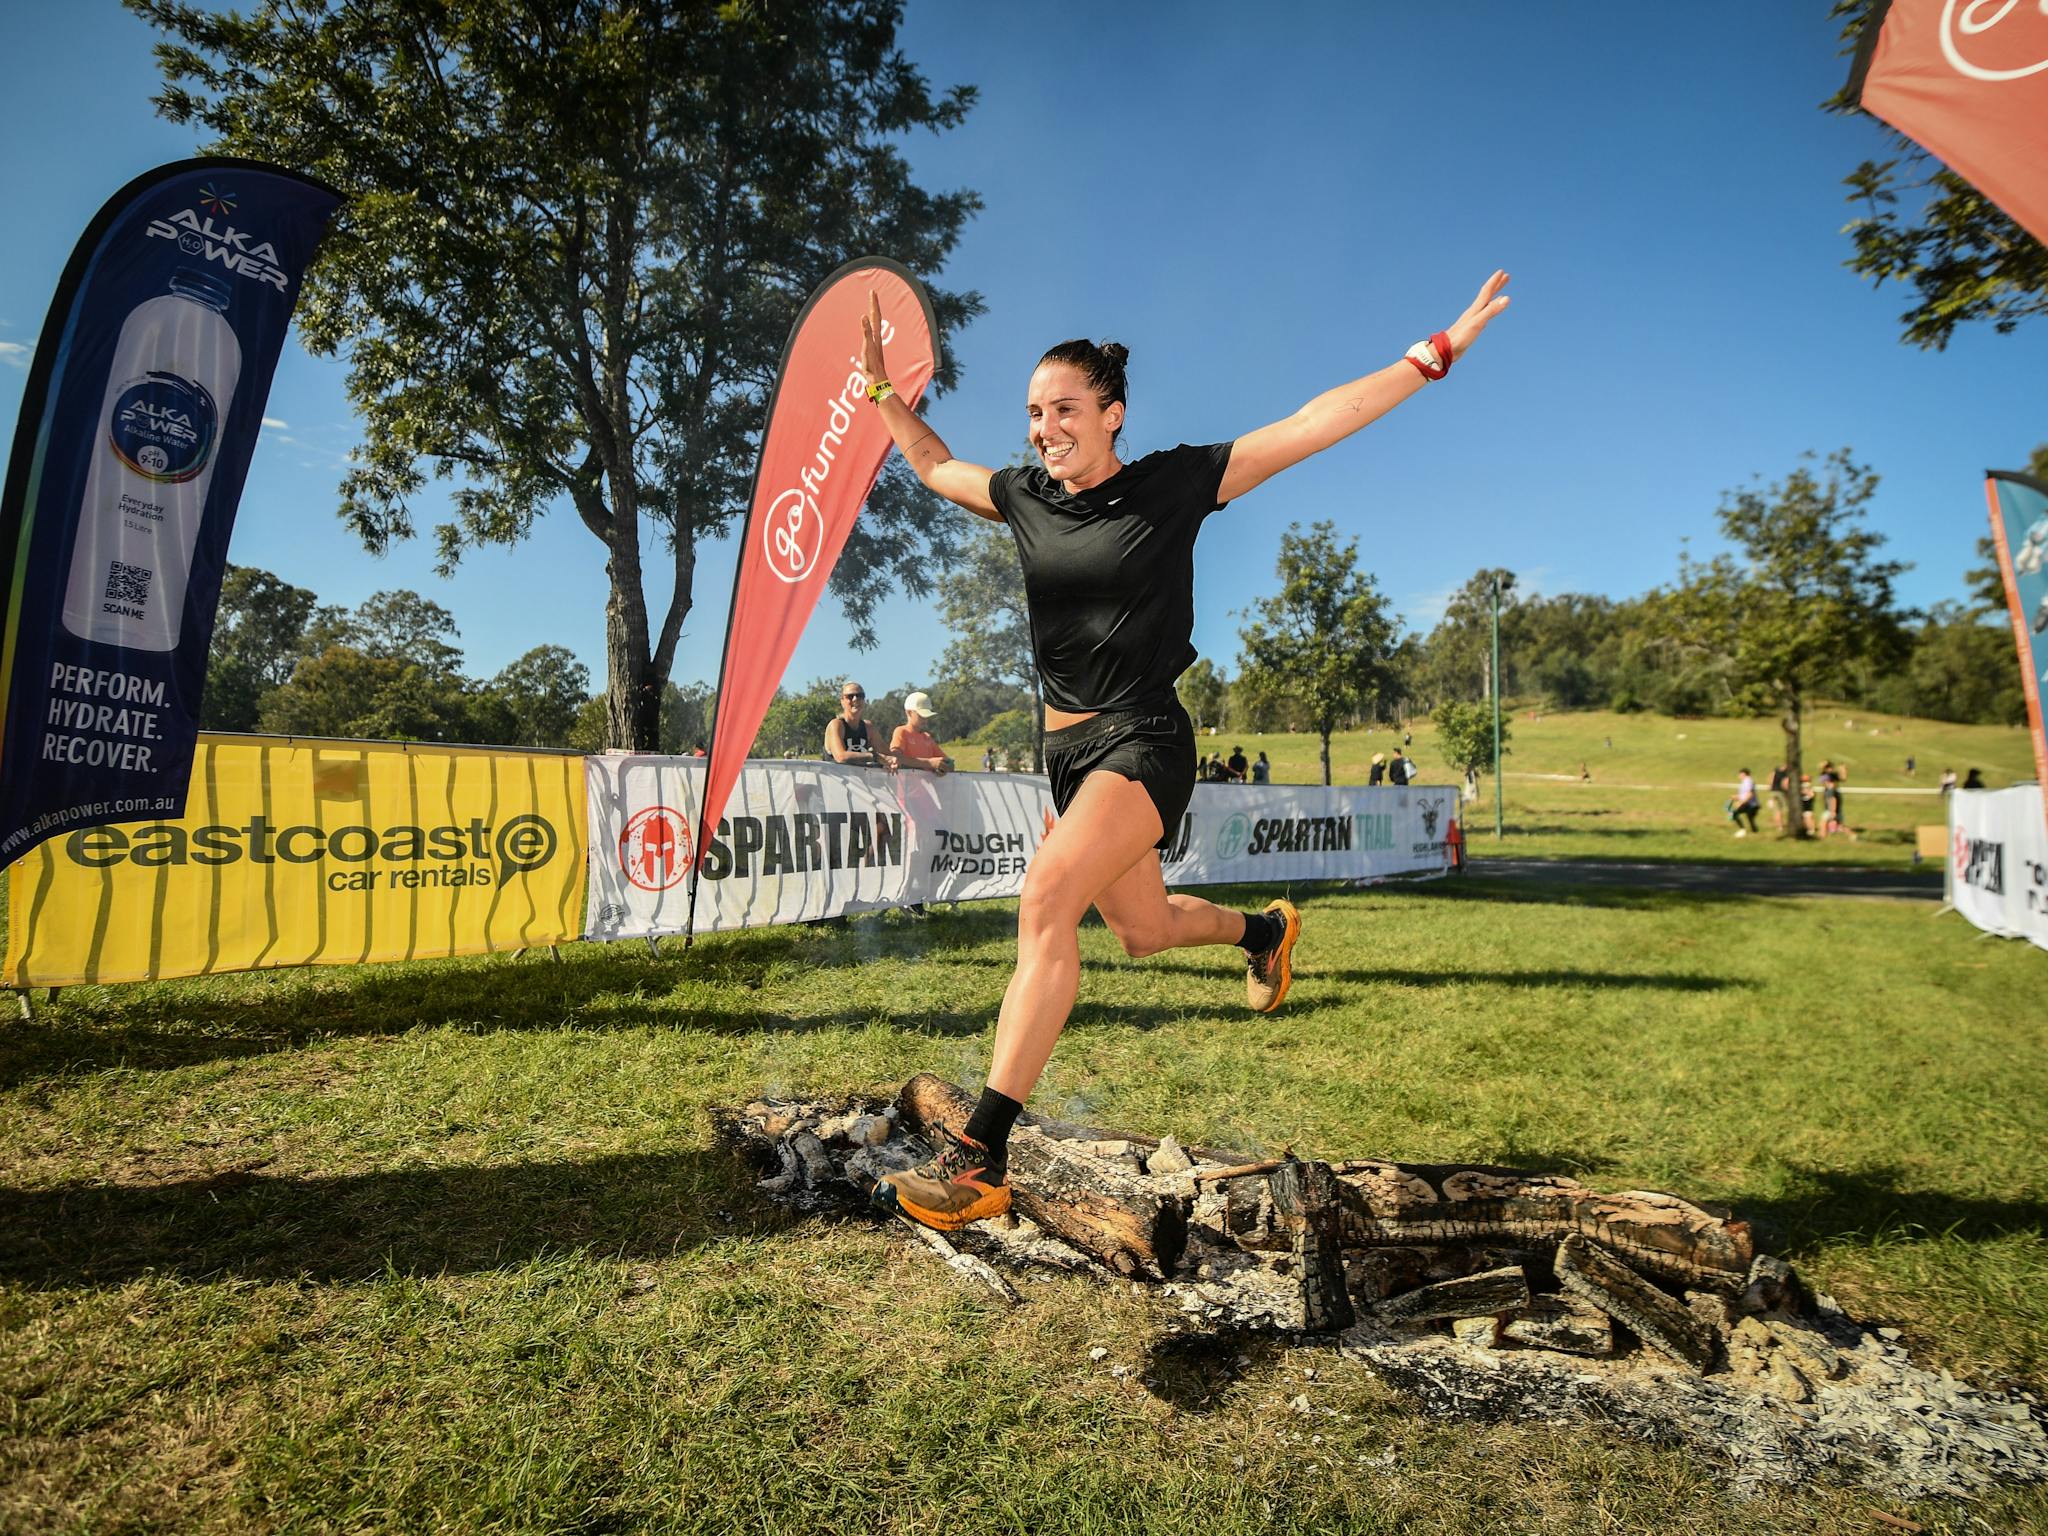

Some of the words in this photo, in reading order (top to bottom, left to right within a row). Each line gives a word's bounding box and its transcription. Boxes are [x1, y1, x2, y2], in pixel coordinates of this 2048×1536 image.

[168, 208, 280, 266] ALKA
[129, 399, 193, 428] ALKA
[123, 424, 162, 443] Alkaline
[163, 435, 189, 449] Water
[140, 454, 164, 469] 9-10
[148, 450, 160, 458] pH
[118, 502, 165, 522] Hydration
[121, 493, 165, 514] Everyday
[103, 602, 130, 617] SCAN
[130, 607, 145, 620] ME
[50, 661, 171, 708] PERFORM.
[47, 697, 163, 741] HYDRATE.
[42, 732, 158, 773] RECOVER.
[0, 797, 175, 854] www.alkapower.com.au
[1248, 815, 1352, 855] SPARTAN
[1355, 813, 1397, 852] TRAIL
[66, 816, 491, 868] eastcoast
[700, 811, 903, 881] SPARTAN
[934, 829, 1025, 855] TOUGH
[328, 870, 382, 892] car
[390, 862, 491, 889] rentals
[930, 854, 1027, 876] MUDDER
